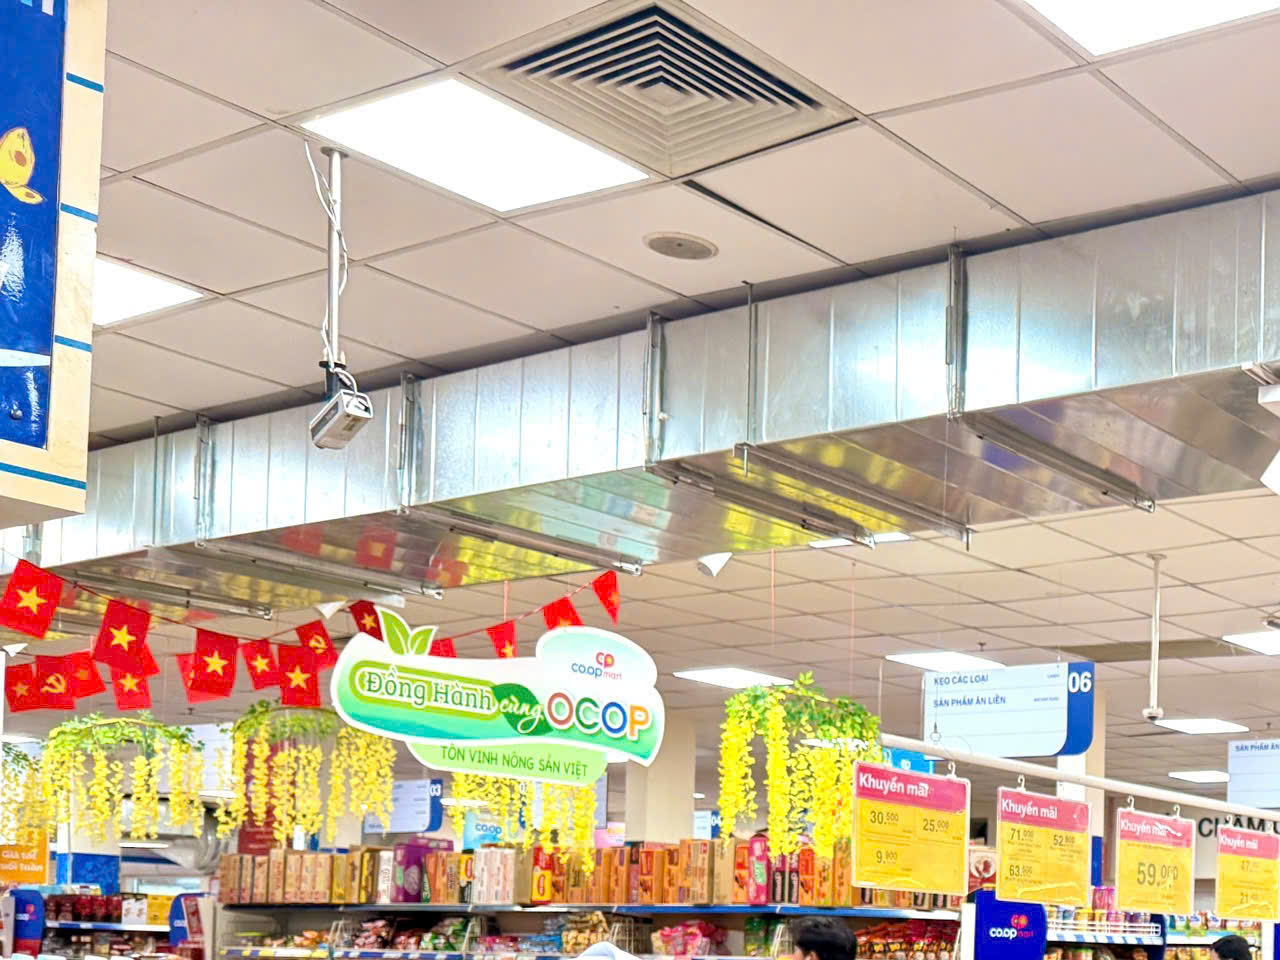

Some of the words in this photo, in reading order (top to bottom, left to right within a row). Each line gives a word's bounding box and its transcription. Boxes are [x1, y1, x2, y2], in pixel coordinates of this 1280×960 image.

[1068, 672, 1092, 693] 06
[365, 666, 426, 707] Đồng
[434, 683, 494, 712] Hành
[499, 695, 544, 734] cùng
[547, 692, 650, 739] OCOP
[441, 744, 466, 762] TÔN
[468, 748, 499, 766] VINH
[502, 750, 535, 771] NÔNG
[538, 756, 562, 774] SẢN
[564, 759, 588, 778] VIỆT
[859, 773, 905, 795] Khuyến
[1002, 799, 1038, 818] Khuyến
[1120, 819, 1151, 835] Khuyến
